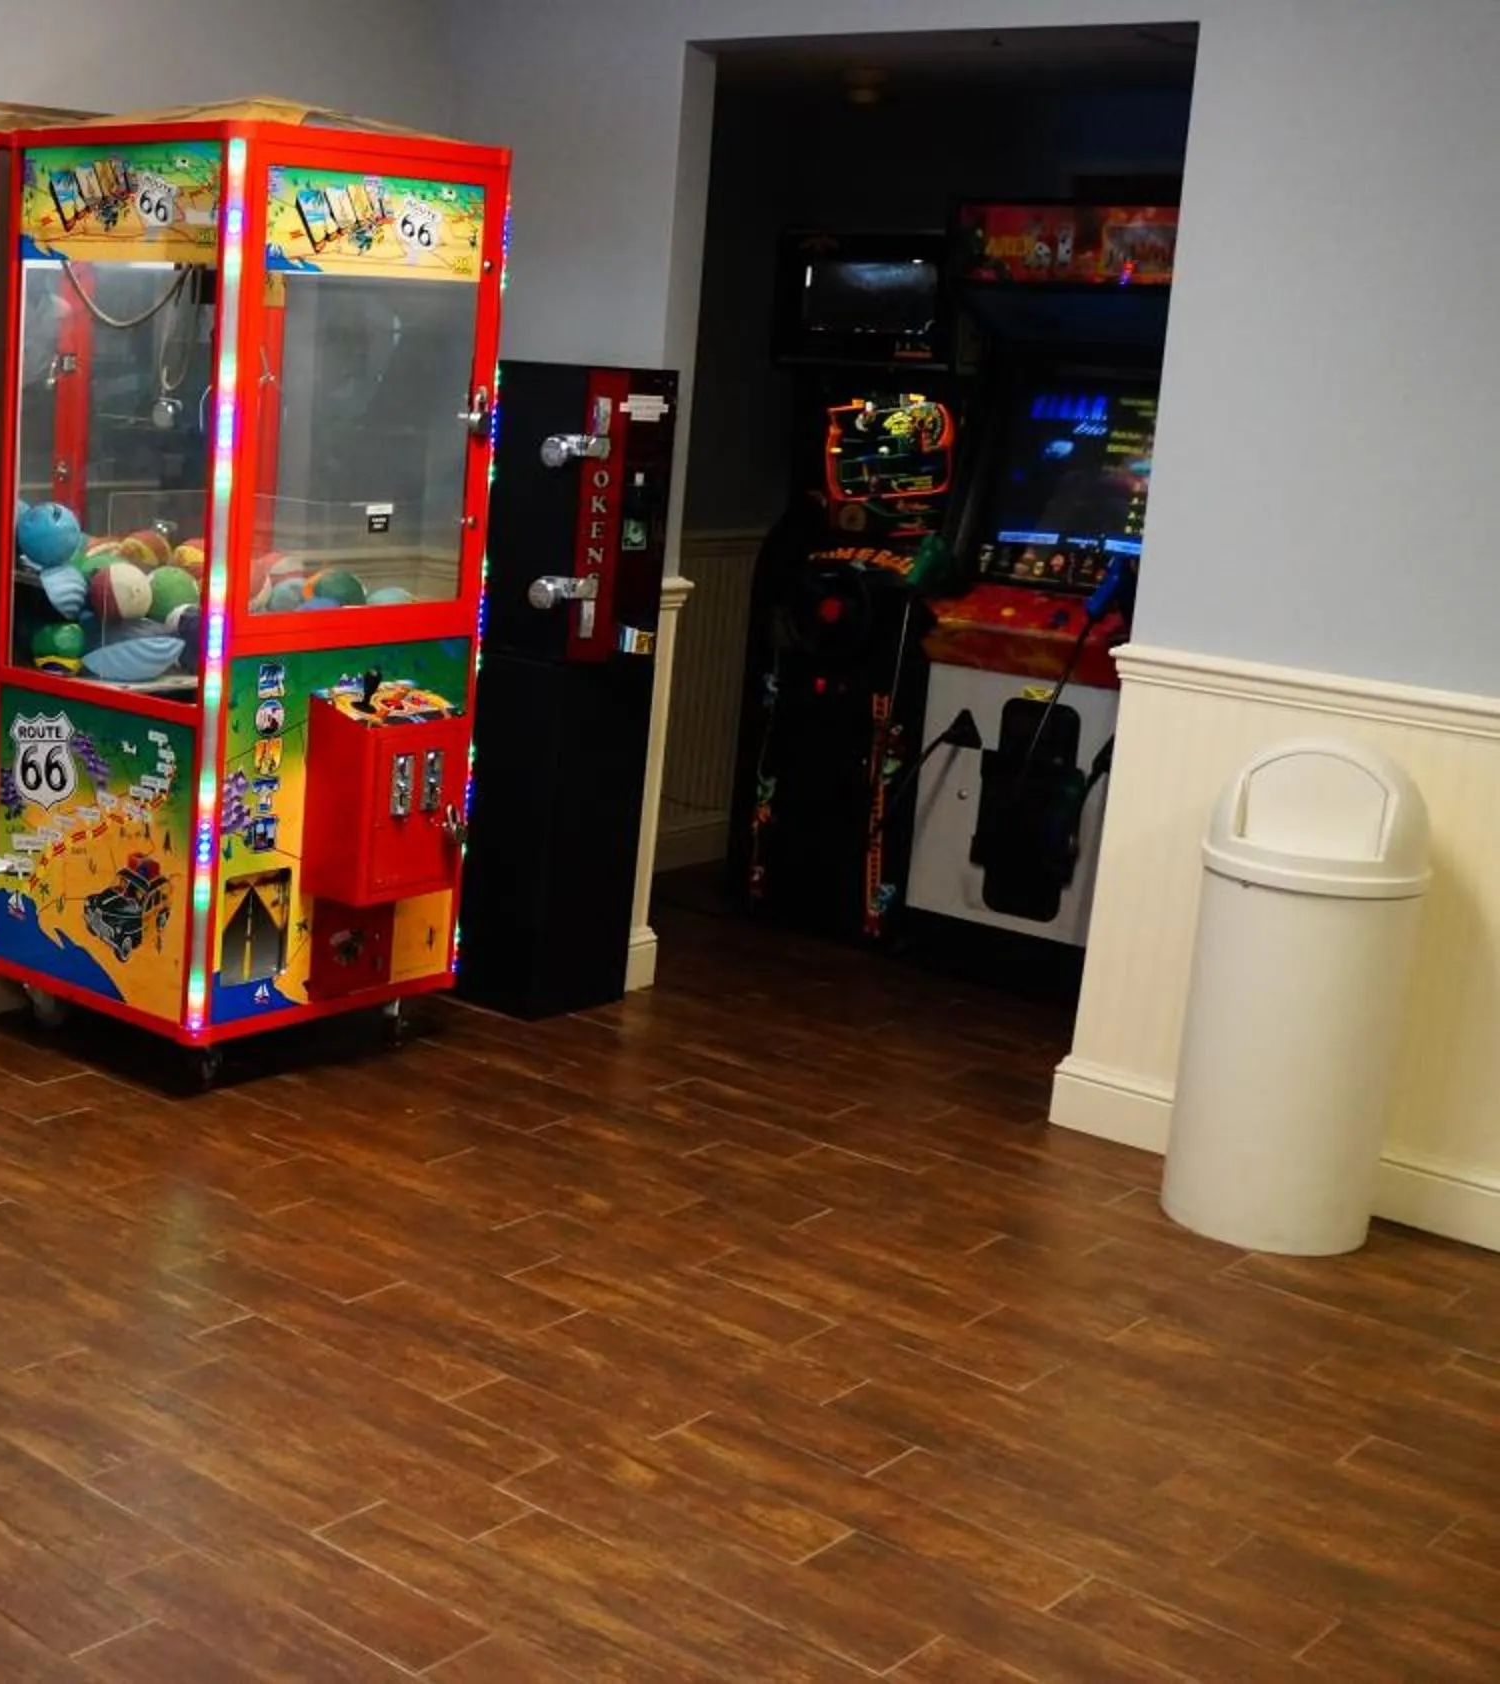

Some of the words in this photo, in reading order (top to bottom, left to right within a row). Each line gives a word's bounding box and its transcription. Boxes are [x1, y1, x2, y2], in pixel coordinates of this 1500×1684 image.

[139, 190, 169, 223] 66
[400, 213, 432, 247] 66
[587, 470, 610, 579] OKEN
[17, 724, 63, 739] ROUTE
[20, 745, 67, 792] 66
